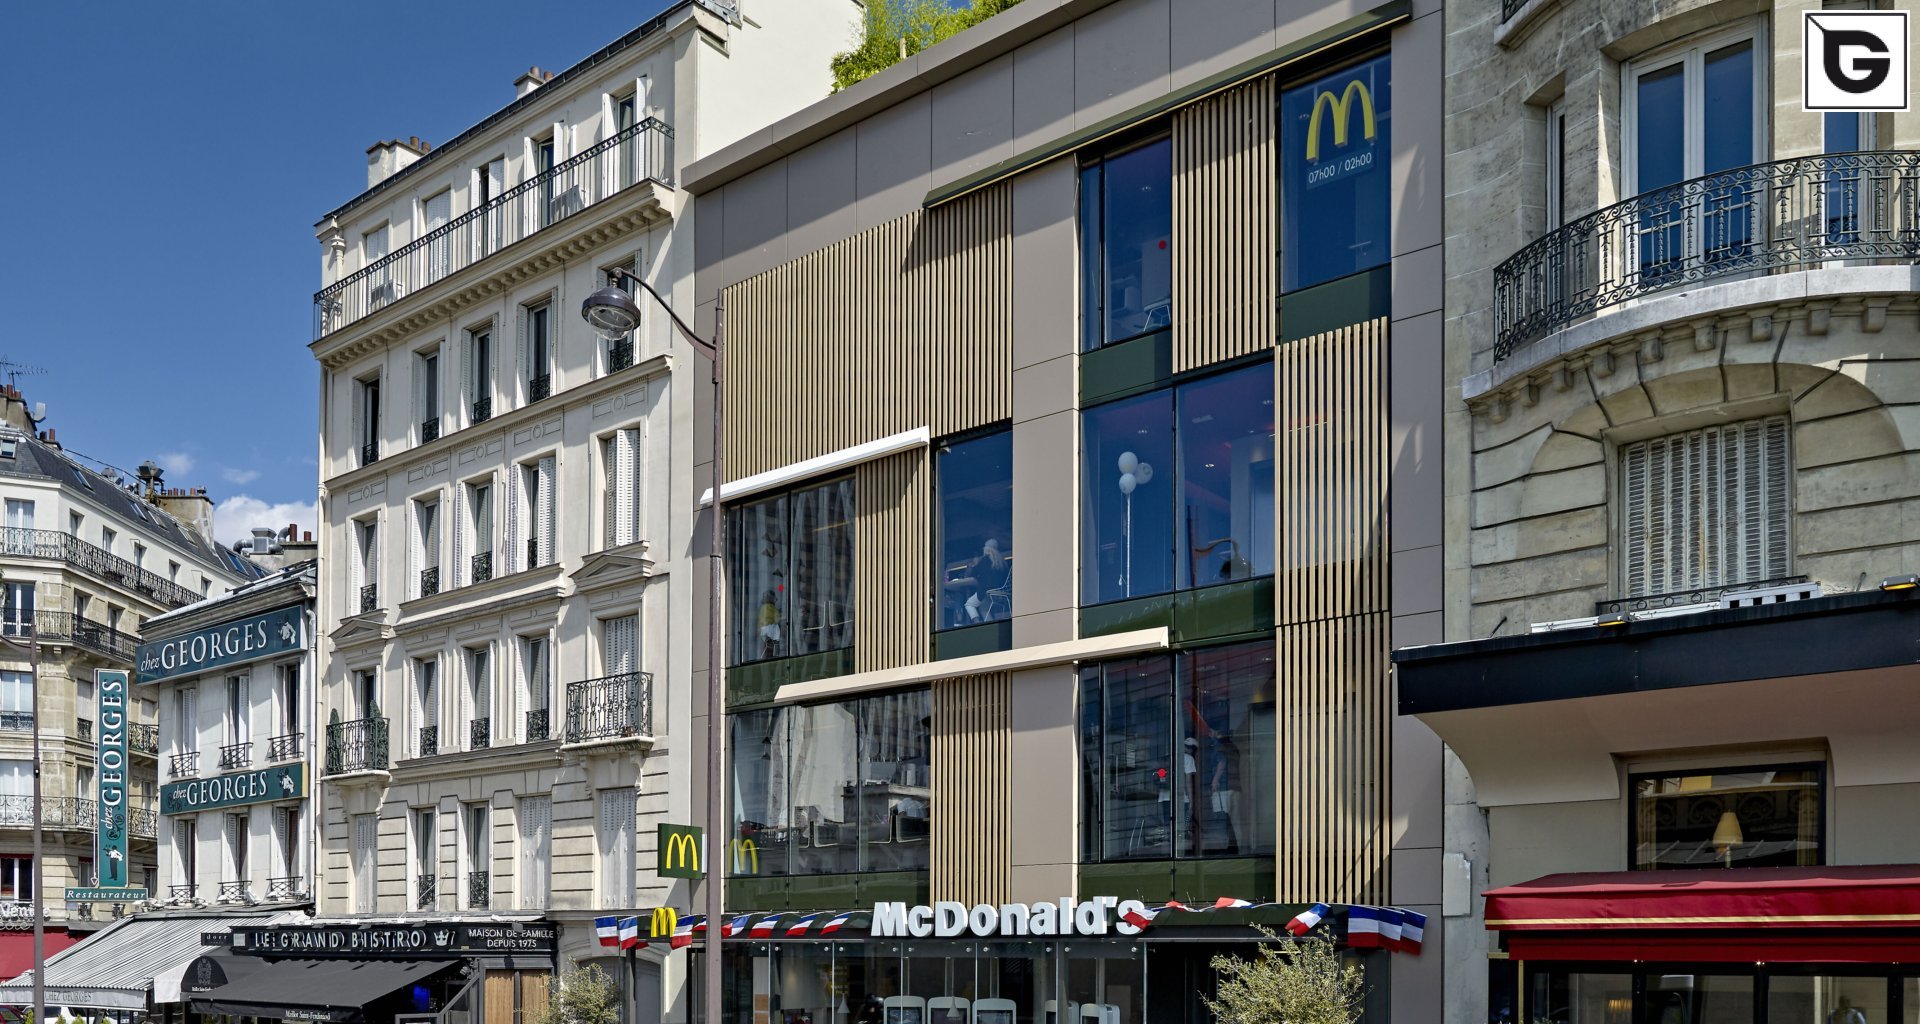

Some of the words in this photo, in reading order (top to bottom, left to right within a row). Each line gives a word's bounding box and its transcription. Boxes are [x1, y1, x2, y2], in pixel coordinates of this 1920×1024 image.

[1308, 165, 1336, 184] 07h00
[1344, 152, 1372, 171] 02h00
[140, 652, 160, 672] chez
[161, 620, 267, 670] GEORGES
[102, 679, 123, 807] GEORGES
[172, 785, 187, 800] chez
[186, 771, 268, 806] GEORGES
[101, 806, 113, 830] chez
[66, 889, 147, 900] Restaurateur
[870, 896, 1146, 938] McDonald's
[255, 933, 270, 948] LE
[281, 932, 340, 948] GRAND
[351, 931, 420, 948] BISTRO
[468, 929, 503, 938] MAISON
[521, 930, 554, 939] FAMILLE
[487, 939, 516, 948] DEPUIS
[518, 939, 537, 948] 1975
[62, 991, 92, 1002] GEORGES
